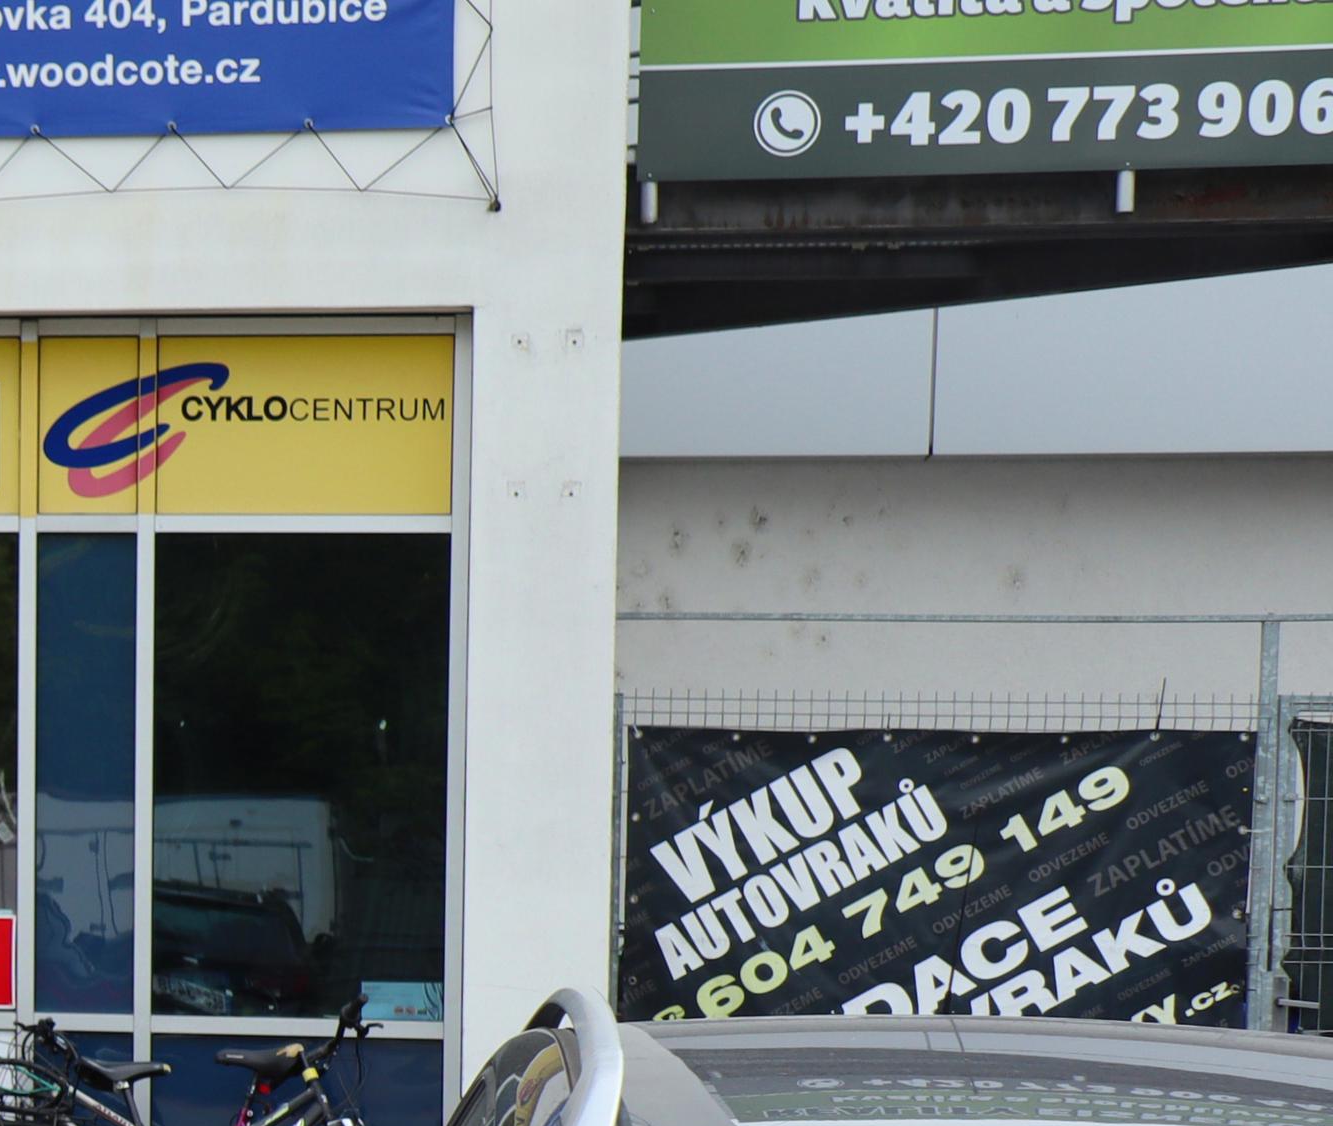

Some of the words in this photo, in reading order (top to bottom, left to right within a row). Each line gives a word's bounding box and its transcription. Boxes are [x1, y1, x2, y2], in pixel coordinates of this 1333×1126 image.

[84, 0, 167, 34] 404,
[182, 0, 388, 27] Pardubice
[844, 88, 1032, 147] +420
[1046, 83, 1181, 143] 773
[1196, 78, 1333, 139] 906
[180, 395, 446, 423] CYKLOCENTRUM
[958, 765, 1046, 820] ZAPLATÍME
[1124, 779, 1211, 832] ODVEZEME
[649, 746, 864, 905] VÝKUP
[1086, 804, 1242, 898] ZAPLATÍME
[653, 777, 950, 982] AUTOVRAKŮ
[1027, 831, 1111, 884] ODVEZEME
[695, 925, 837, 1019] 604
[841, 842, 987, 940] 749
[999, 764, 1133, 854] 149
[931, 884, 1013, 935] ODVEZEME
[837, 935, 919, 985] ODVEZEME
